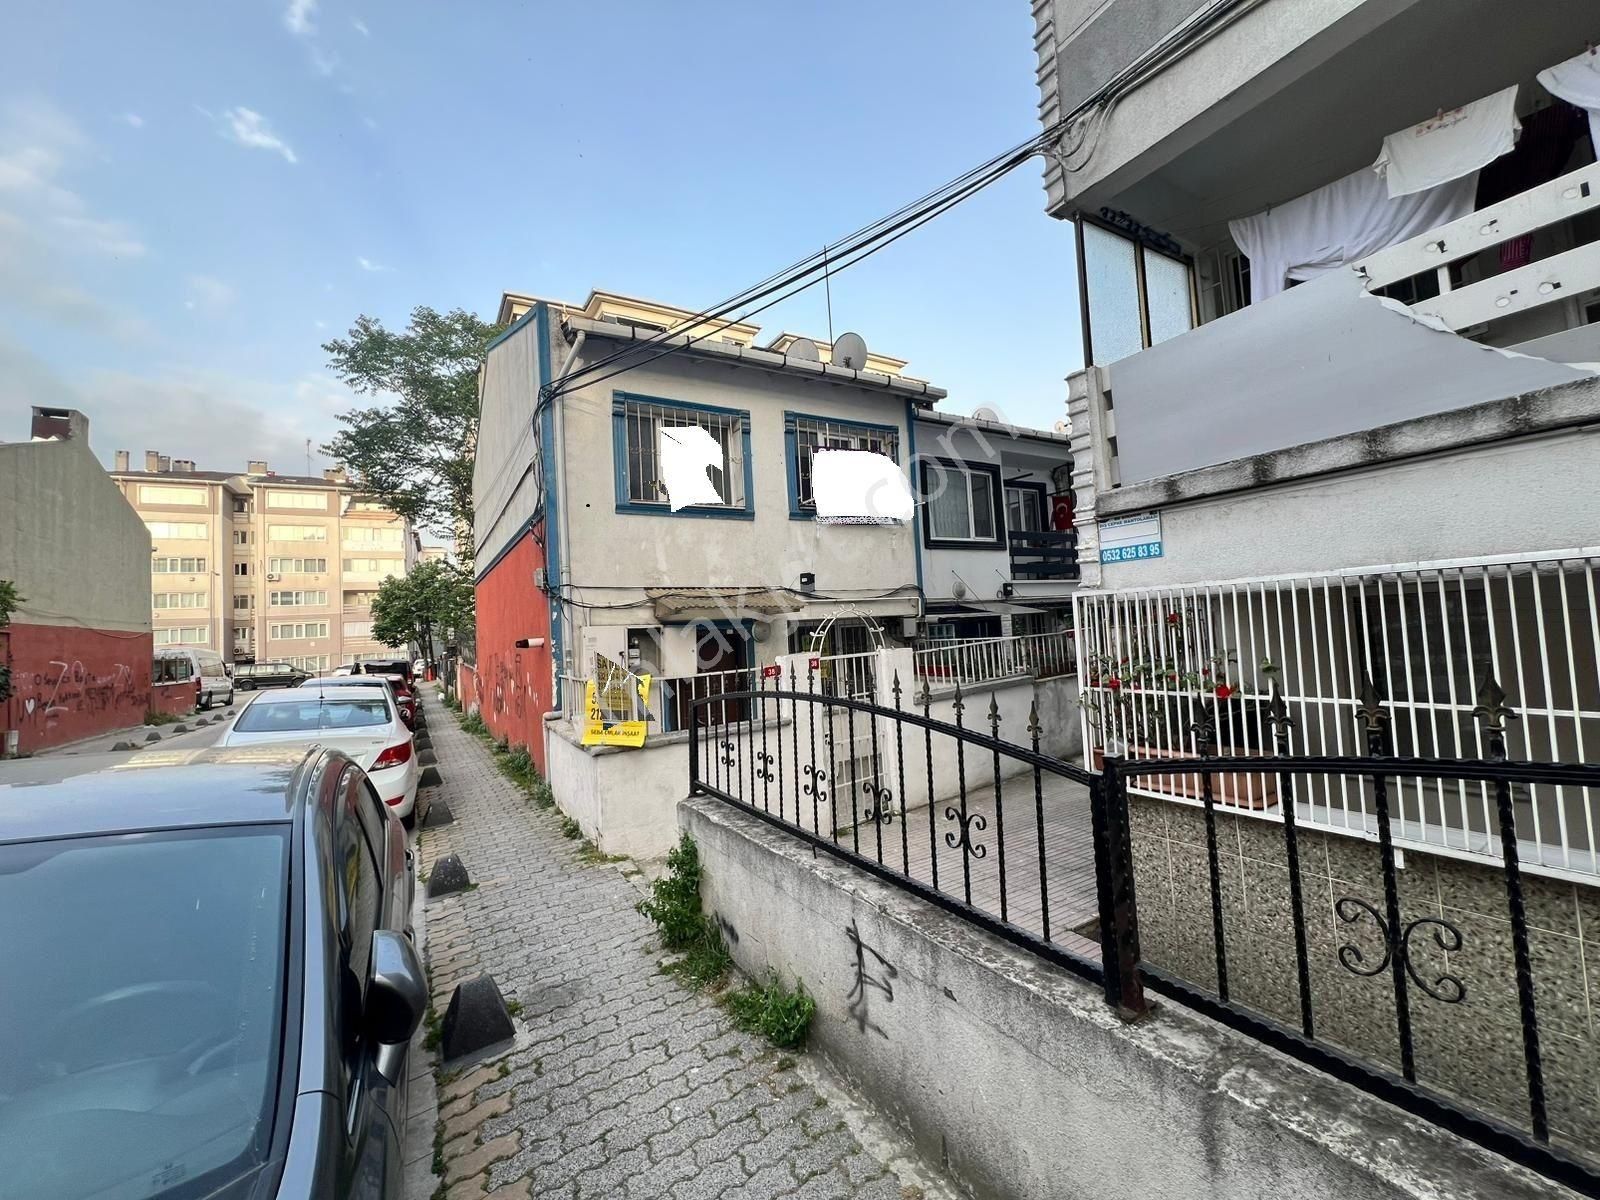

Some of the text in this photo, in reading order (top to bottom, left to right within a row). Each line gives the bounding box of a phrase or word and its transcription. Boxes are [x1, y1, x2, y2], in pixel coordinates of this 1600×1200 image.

[1102, 543, 1160, 562] 0532 625 83 95
